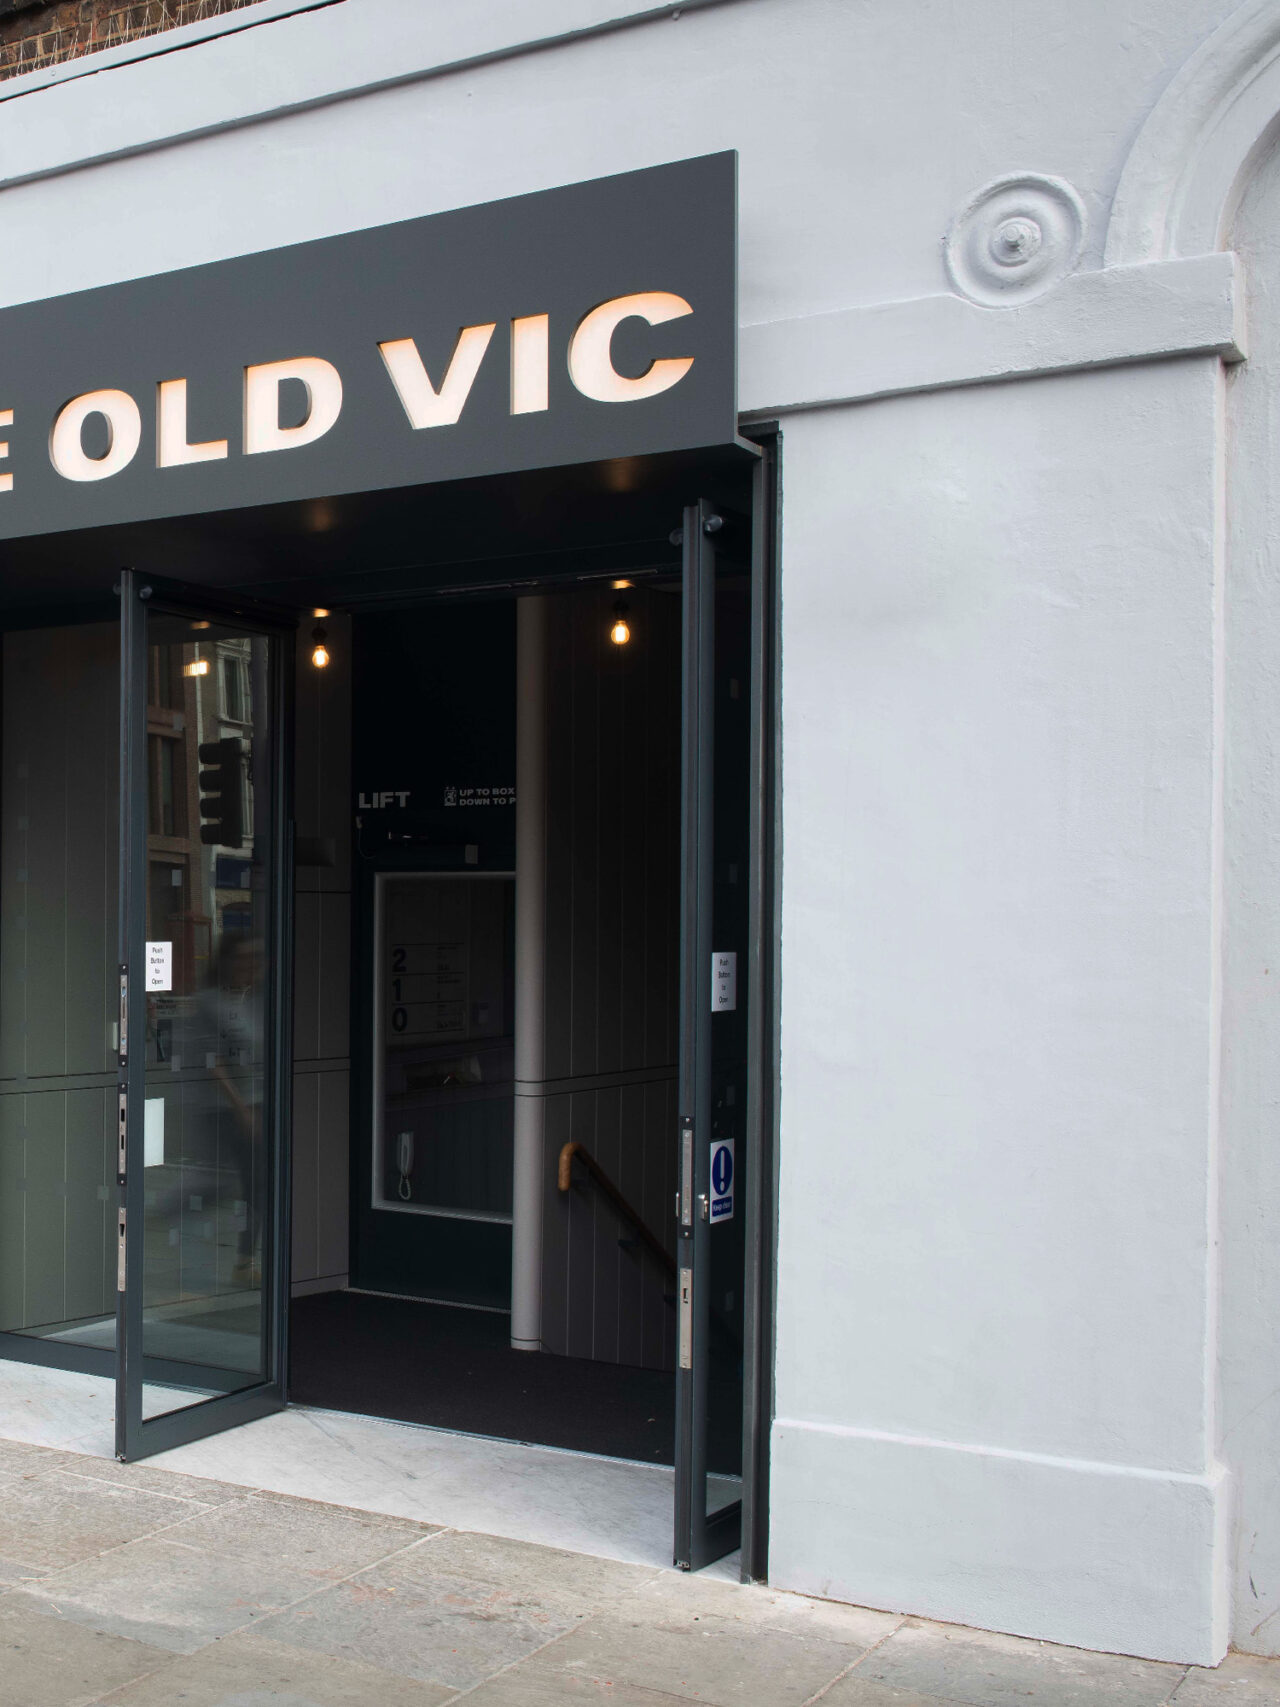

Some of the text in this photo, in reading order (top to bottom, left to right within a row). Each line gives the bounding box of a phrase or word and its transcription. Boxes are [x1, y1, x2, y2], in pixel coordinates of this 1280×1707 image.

[48, 356, 343, 482] OLD
[376, 291, 696, 430] VIC
[359, 791, 411, 809] LIFT
[459, 787, 515, 797] UP TO BOX
[459, 798, 490, 806] DOWN
[492, 797, 507, 805] TO
[392, 948, 407, 972] 2
[392, 979, 402, 1001] 1
[392, 1007, 408, 1032] 0
